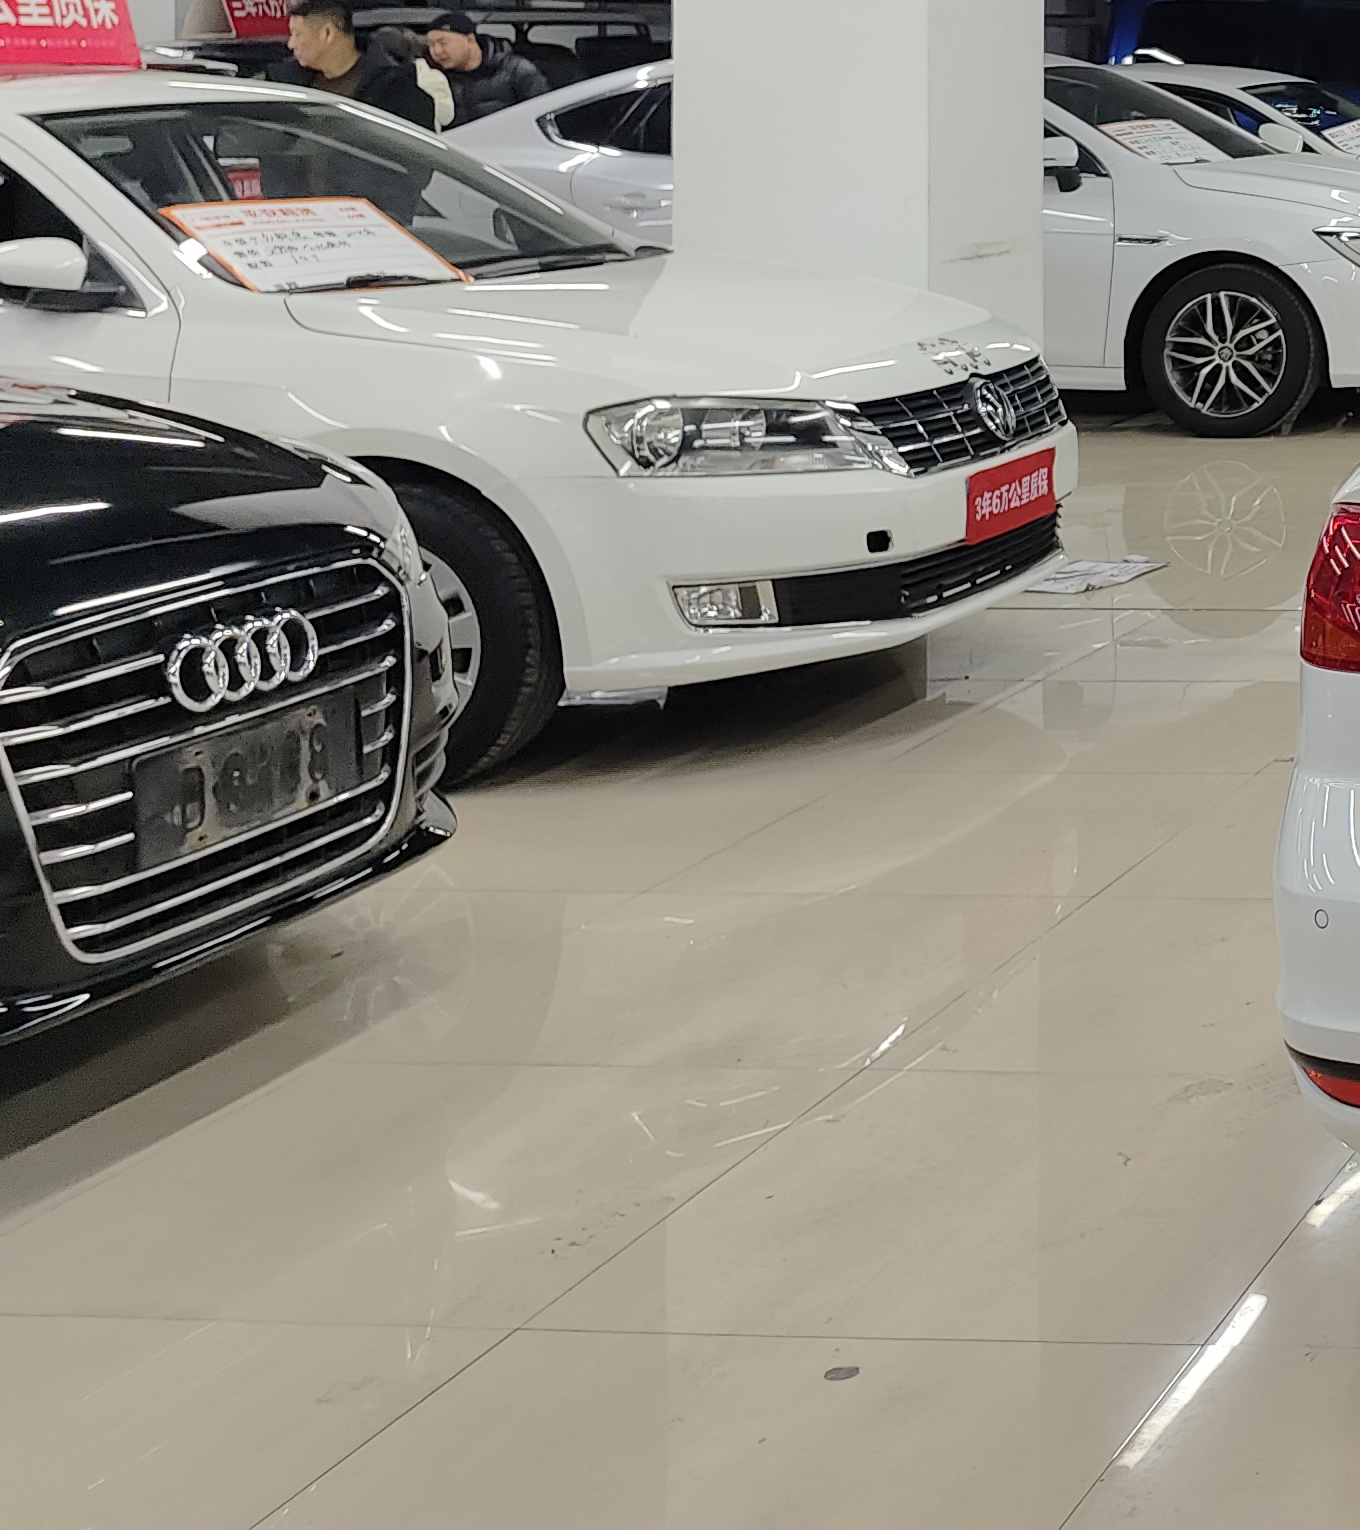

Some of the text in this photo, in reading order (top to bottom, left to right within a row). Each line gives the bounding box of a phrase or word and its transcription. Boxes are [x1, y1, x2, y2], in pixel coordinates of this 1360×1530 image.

[973, 466, 1050, 522] 3年6万公里质保
